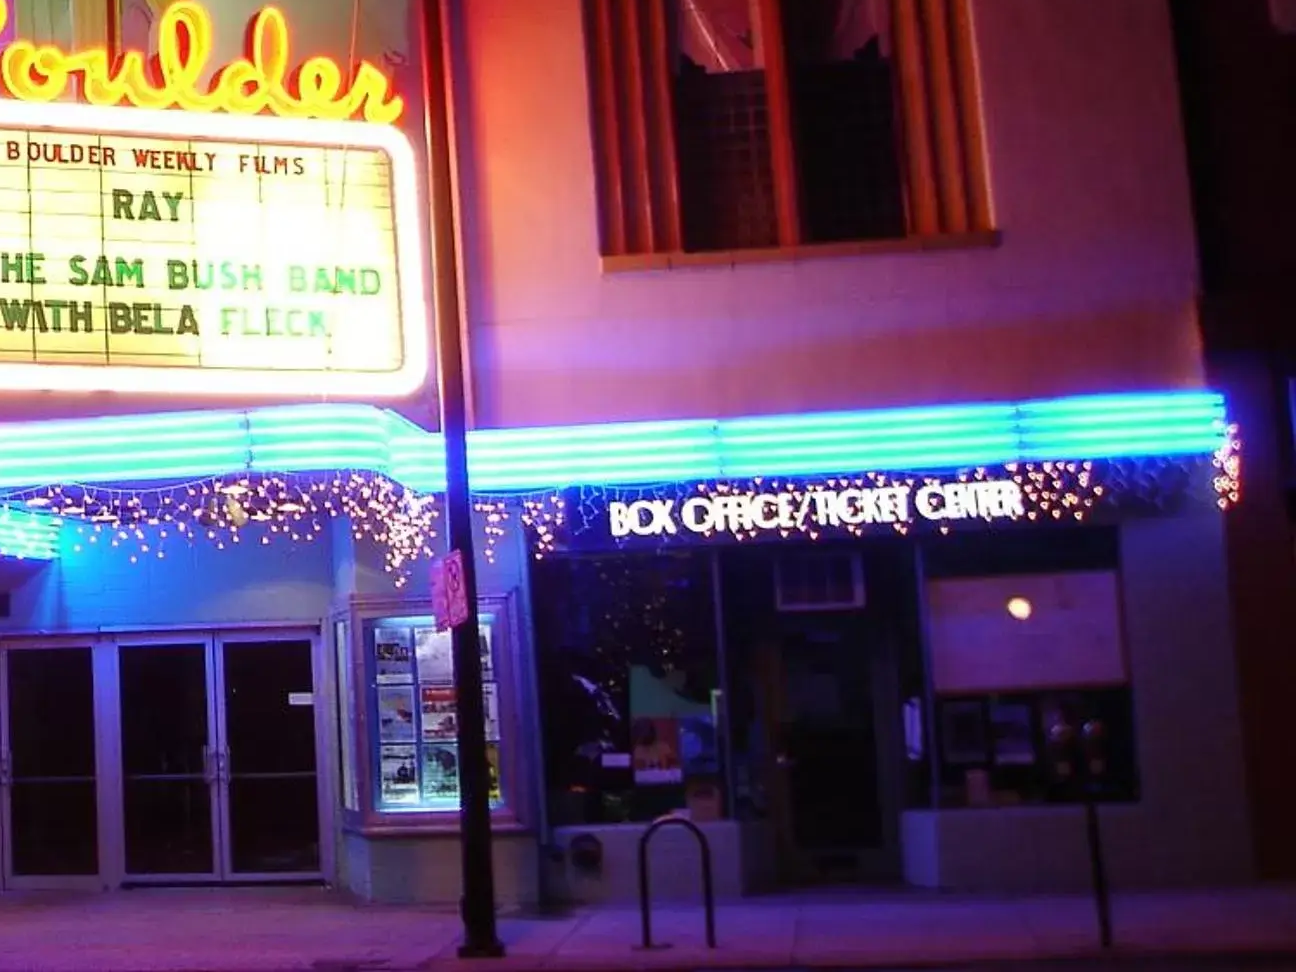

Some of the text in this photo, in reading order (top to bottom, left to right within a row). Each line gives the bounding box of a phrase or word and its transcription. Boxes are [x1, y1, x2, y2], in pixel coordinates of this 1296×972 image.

[7, 141, 116, 166] BOULDER
[133, 149, 216, 171] WEEKLY
[239, 154, 305, 175] FILMS
[112, 188, 183, 222] RAY
[69, 255, 145, 288] SAM
[167, 259, 263, 291] BUSH
[289, 264, 381, 296] BAND
[109, 302, 199, 335] BELA
[220, 307, 327, 337] FLECK
[610, 500, 677, 536] BOX
[916, 481, 1024, 520] CENTER
